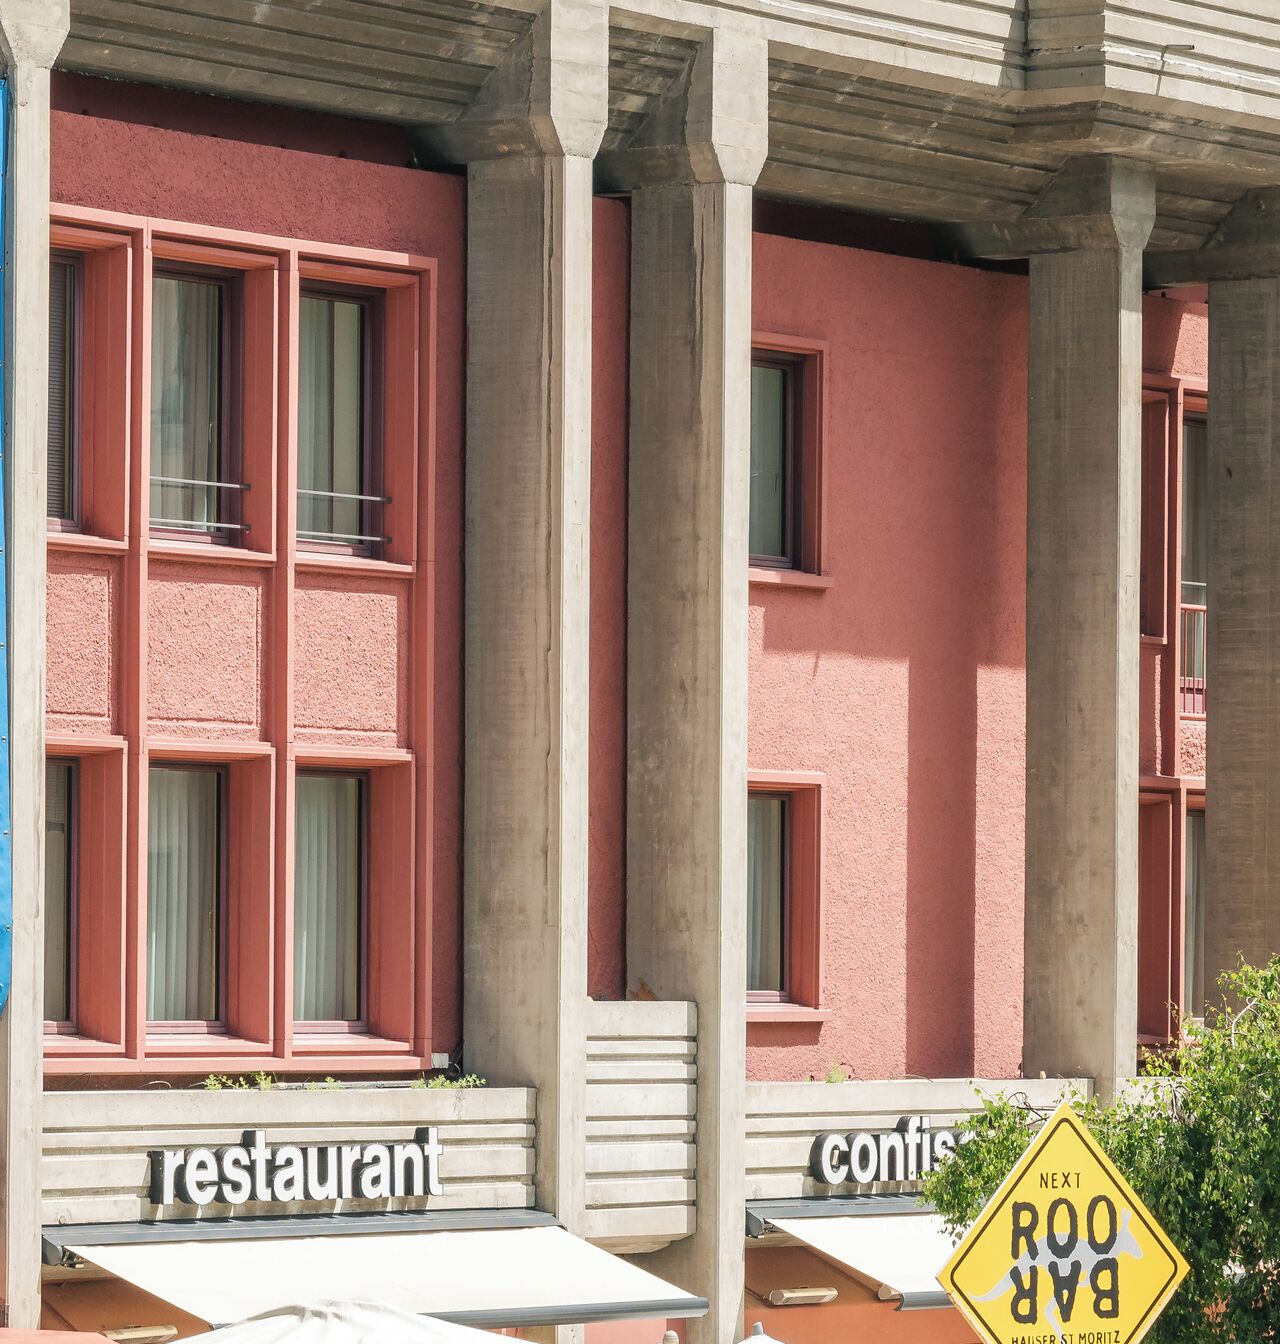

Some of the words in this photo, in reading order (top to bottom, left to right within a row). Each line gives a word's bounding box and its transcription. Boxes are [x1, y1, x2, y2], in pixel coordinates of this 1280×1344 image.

[153, 1126, 445, 1205] restaurant
[1040, 1171, 1081, 1189] NEXT
[1010, 1194, 1118, 1260] ROO
[1009, 1257, 1120, 1325] BAR
